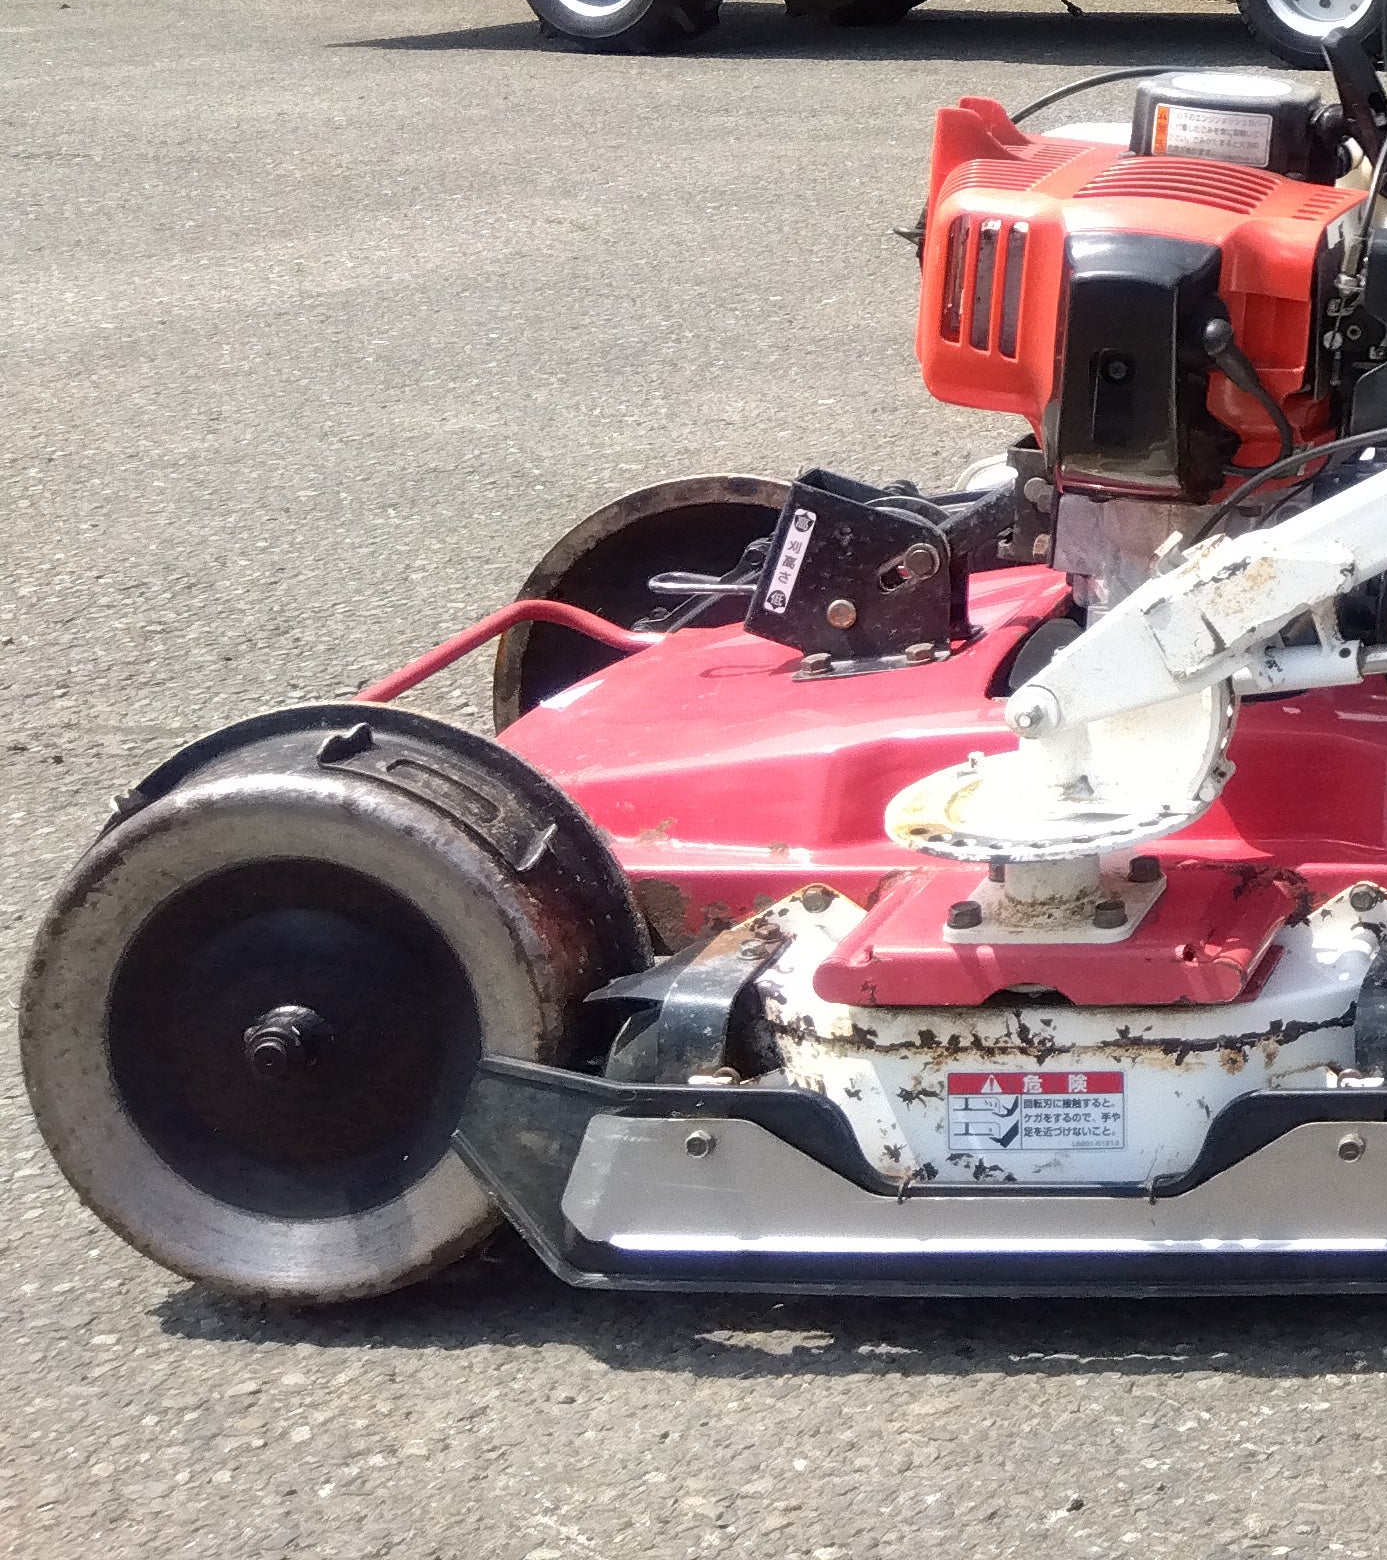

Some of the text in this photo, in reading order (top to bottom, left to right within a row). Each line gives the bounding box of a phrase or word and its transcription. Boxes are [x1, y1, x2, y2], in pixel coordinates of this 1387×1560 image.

[1023, 1074, 1088, 1094] 危険
[1023, 1112, 1121, 1124] ケガをするので、手や
[1023, 1126, 1116, 1138] 足を近づけないこと。
